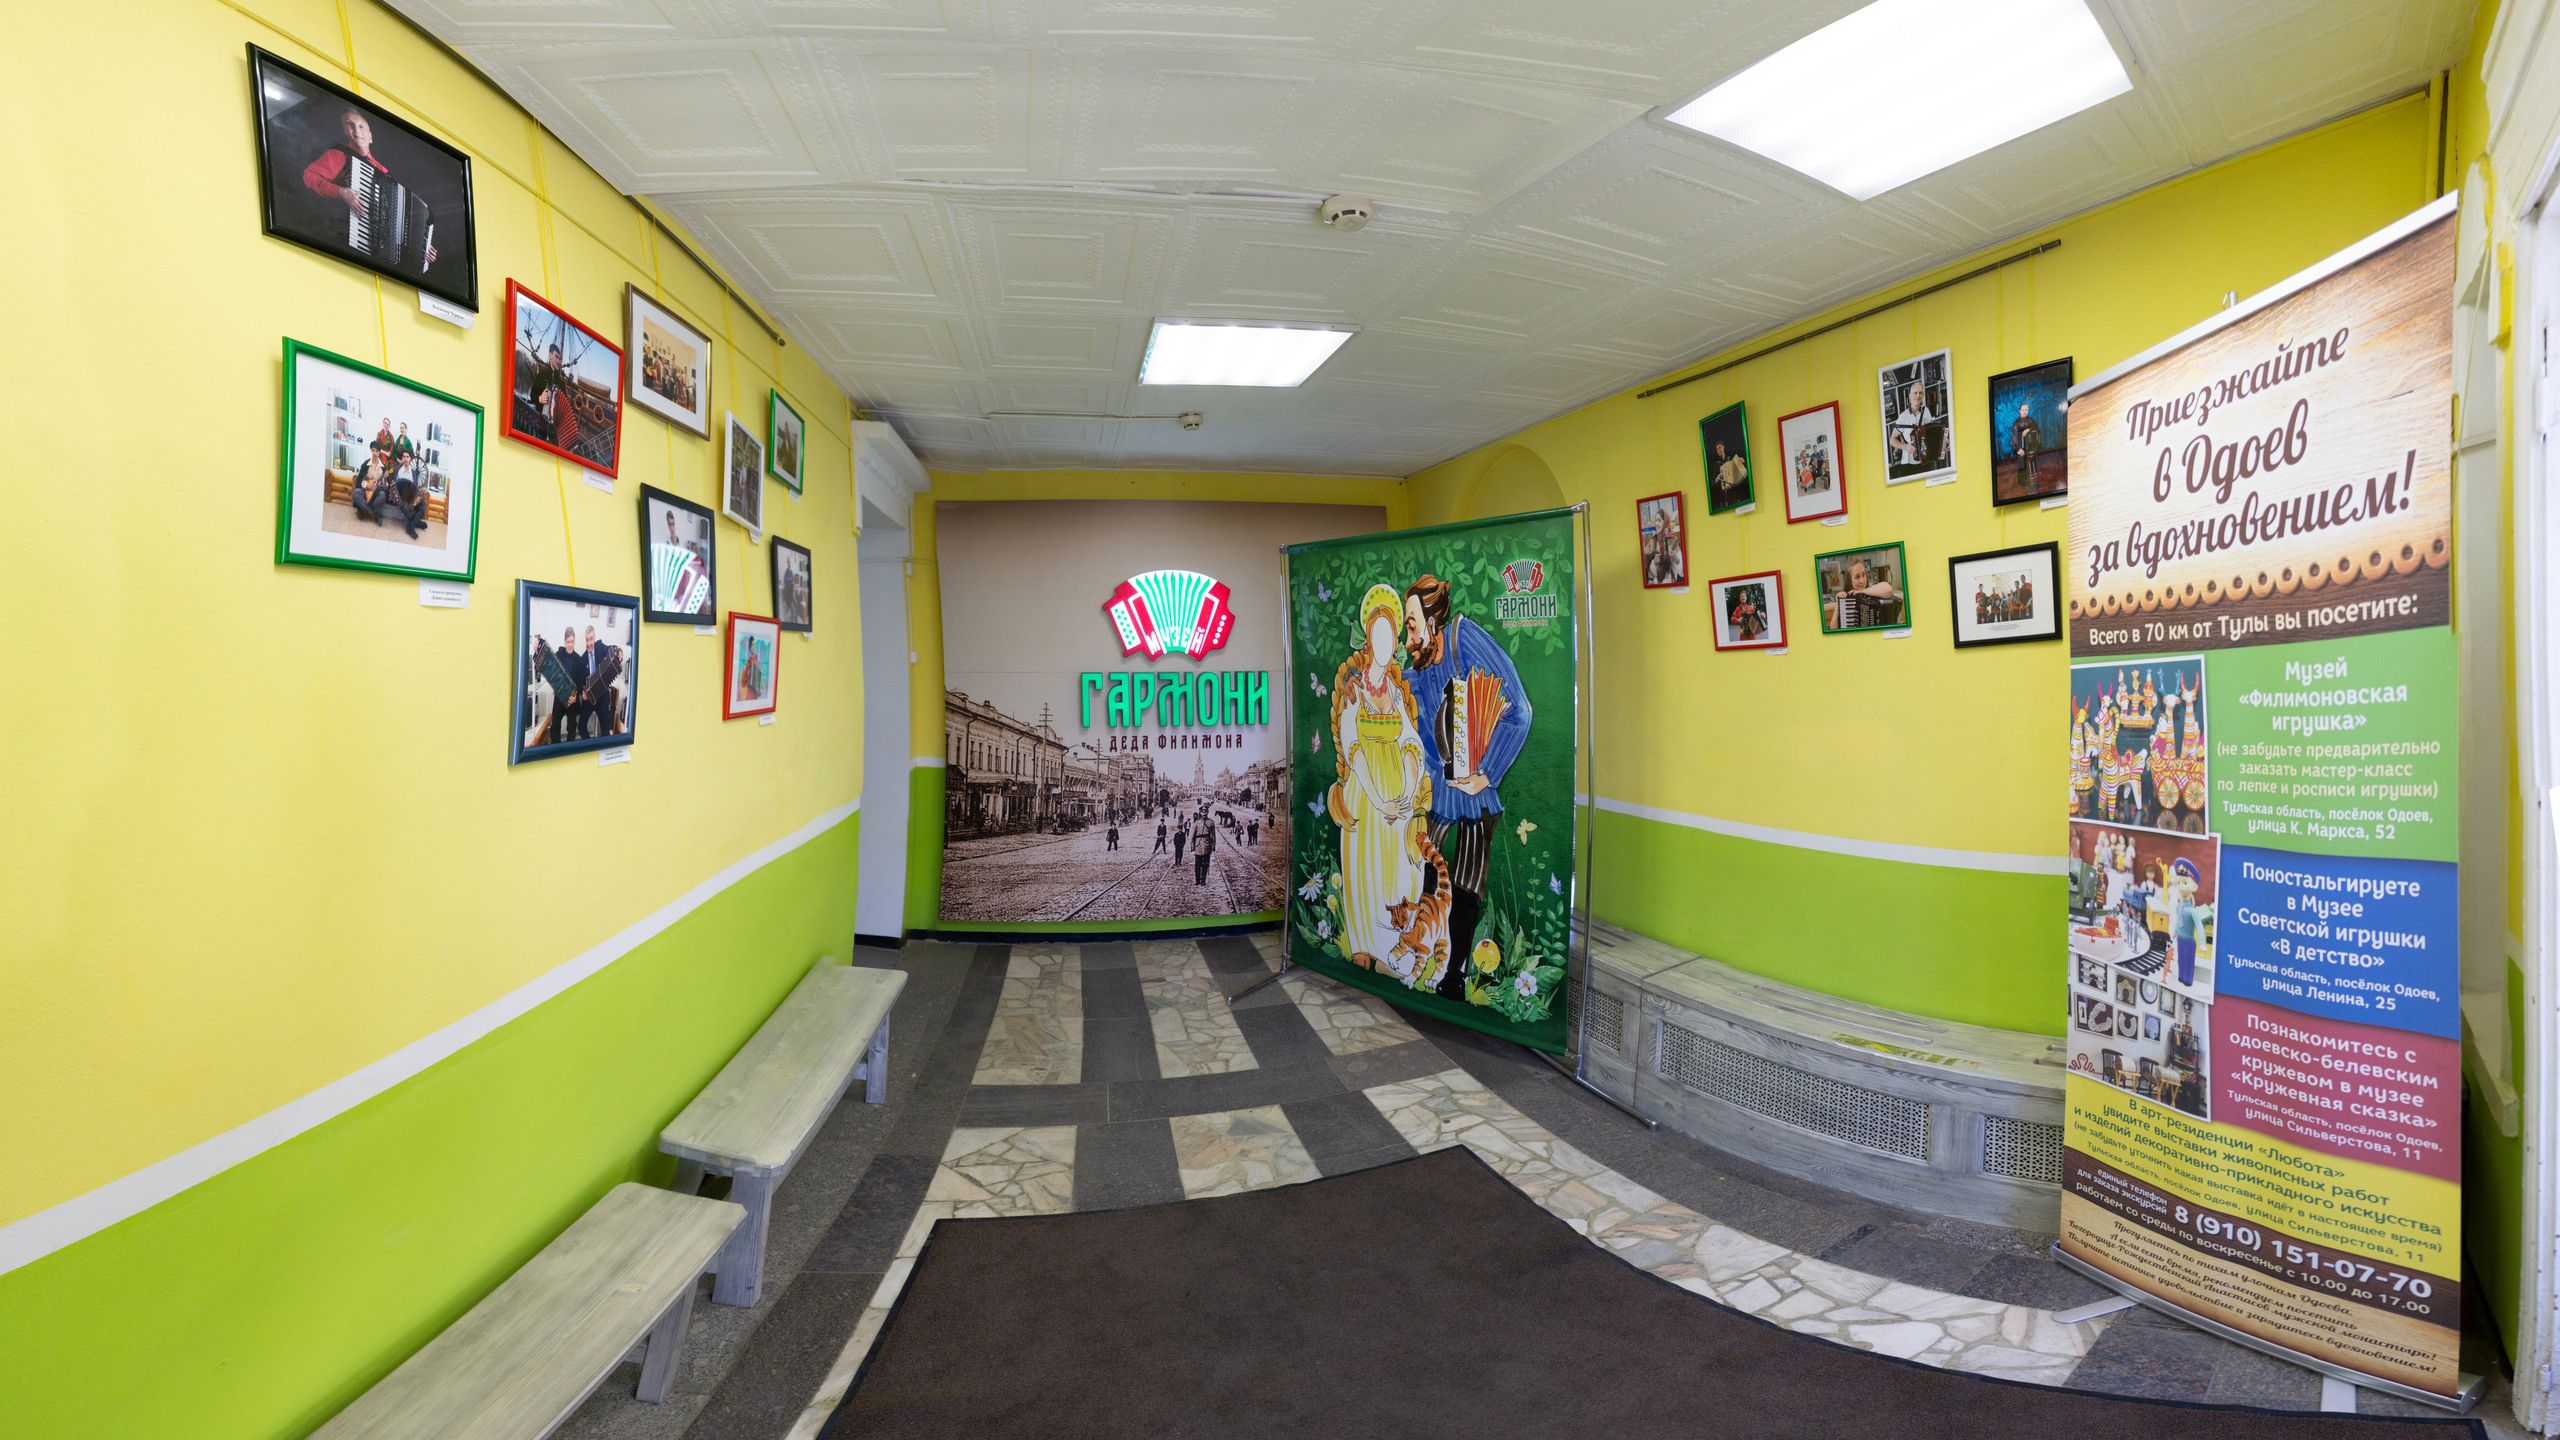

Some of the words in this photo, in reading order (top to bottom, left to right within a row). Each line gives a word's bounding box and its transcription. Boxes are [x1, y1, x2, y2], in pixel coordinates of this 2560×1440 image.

[2126, 327, 2349, 445] Приезжайте
[2153, 447, 2172, 501] в
[2182, 398, 2309, 504] Одоев
[2088, 540, 2118, 587] за
[2126, 449, 2417, 578] вдохновением!
[1495, 594, 1557, 619] ГАРМОНИ
[2090, 629, 2128, 645] Всего
[2133, 630, 2140, 642] в
[2145, 623, 2164, 642] 70
[2168, 624, 2187, 640] км
[2193, 620, 2212, 637] от
[2218, 613, 2269, 642] Тулы
[2275, 610, 2301, 629] вы
[2308, 594, 2418, 627] посетите:
[1145, 626, 1205, 655] МУЗЕЙ
[2285, 657, 2347, 685] Музей
[1081, 671, 1269, 727] ГАРМОНИ
[2239, 684, 2407, 708] «Филимоновская
[1110, 735, 1149, 752] ДЕДА
[1158, 734, 1242, 750] ФИЛИМОНА
[2273, 711, 2367, 736] игрушка»
[2218, 741, 2237, 757] (не
[2242, 741, 2302, 760] забудьте
[2306, 740, 2440, 760] предварительно
[2239, 761, 2297, 777] заказать
[2302, 762, 2413, 781] мастер-класс
[2218, 780, 2234, 792] по
[2238, 780, 2277, 794] лепке
[2281, 782, 2289, 795] и
[2292, 782, 2355, 799] росписи
[2361, 781, 2438, 801] игрушки)
[2223, 801, 2273, 818] Тульская
[2276, 804, 2324, 821] область,
[2329, 806, 2383, 822] посёлок
[2387, 809, 2433, 824] Одоев,
[2248, 818, 2287, 835] улица
[2290, 820, 2303, 836] К.
[2307, 822, 2369, 841] Маркса,
[2375, 824, 2395, 839] 52
[2243, 862, 2420, 899] Поностальгируете
[2238, 908, 2329, 938] Советской
[2336, 926, 2426, 950] игрушки
[2287, 896, 2296, 910] в
[2302, 894, 2363, 919] Музее
[2271, 939, 2290, 954] «В
[2295, 944, 2385, 968] детство»
[2228, 954, 2277, 974] Тульская
[2281, 966, 2331, 986] область,
[2335, 975, 2390, 994] посёлок
[2394, 983, 2440, 1002] Одоев,
[2263, 977, 2302, 995] улица
[2307, 986, 2369, 1009] Ленина,
[2375, 996, 2396, 1010] 25
[2230, 1033, 2439, 1089] одоевско-белевским
[2247, 1013, 2397, 1060] Познакомитесь
[2405, 1050, 2416, 1063] с
[2231, 1070, 2343, 1111] «Кружевная
[2350, 1103, 2437, 1128] сказка»
[2242, 1055, 2333, 1090] кружевом
[2341, 1081, 2350, 1093] в
[2359, 1084, 2424, 1107] музее
[2130, 1099, 2136, 1110] В
[2141, 1105, 2253, 1151] арт-резиденции
[2258, 1147, 2345, 1178] «Любота»
[2228, 1090, 2278, 1111] Тульская
[2281, 1107, 2332, 1128] область,
[2336, 1122, 2392, 1140] посёлок
[2396, 1133, 2442, 1152] Одоев,
[2245, 1108, 2283, 1127] улица
[2287, 1120, 2396, 1157] Сильверстова,
[2402, 1148, 2421, 1160] 11
[2075, 1107, 2081, 1115] и
[2085, 1110, 2130, 1138] изделий
[2134, 1133, 2334, 1209] декоративно-прикладного
[2341, 1203, 2442, 1235] искусства
[2103, 1105, 2150, 1131] увидите
[2154, 1127, 2217, 1157] выставки
[2222, 1151, 2325, 1191] живописных
[2332, 1185, 2390, 1205] работ
[2074, 1120, 2087, 1132] (не
[2090, 1127, 2127, 1150] забудьте
[2130, 1147, 2172, 1172] уточнить
[2174, 1167, 2203, 1183] какая
[2207, 1180, 2263, 1202] выставка
[2267, 1198, 2294, 1214] идёт
[2310, 1213, 2386, 1237] настоящее
[2391, 1233, 2442, 1252] время)
[2078, 1169, 2091, 1180] для
[2094, 1175, 2120, 1193] заказа
[2122, 1190, 2167, 1214] экскурсий
[2087, 1142, 2123, 1163] Тульская
[2125, 1159, 2161, 1181] область,
[2164, 1177, 2201, 1198] посёлок
[2204, 1193, 2241, 1211] Одоев,
[2247, 1205, 2284, 1225] улица
[2288, 1220, 2399, 1258] Сильверстова,
[2406, 1251, 2423, 1262] 11
[2098, 1169, 2128, 1188] единый
[2130, 1185, 2167, 1205] телефон
[2076, 1182, 2123, 1212] работаем
[2126, 1205, 2138, 1217] со
[2141, 1213, 2176, 1234] среды
[2179, 1229, 2193, 1241] по
[2197, 1238, 2282, 1272] воскресенье
[2287, 1268, 2295, 1277] с
[2300, 1272, 2346, 1292] 10.00
[2351, 1289, 2372, 1299] до
[2379, 1294, 2430, 1314] 17.00
[2175, 1205, 2188, 1224] 8
[2196, 1213, 2261, 1251] (910)
[2271, 1240, 2432, 1298] 151-07-70
